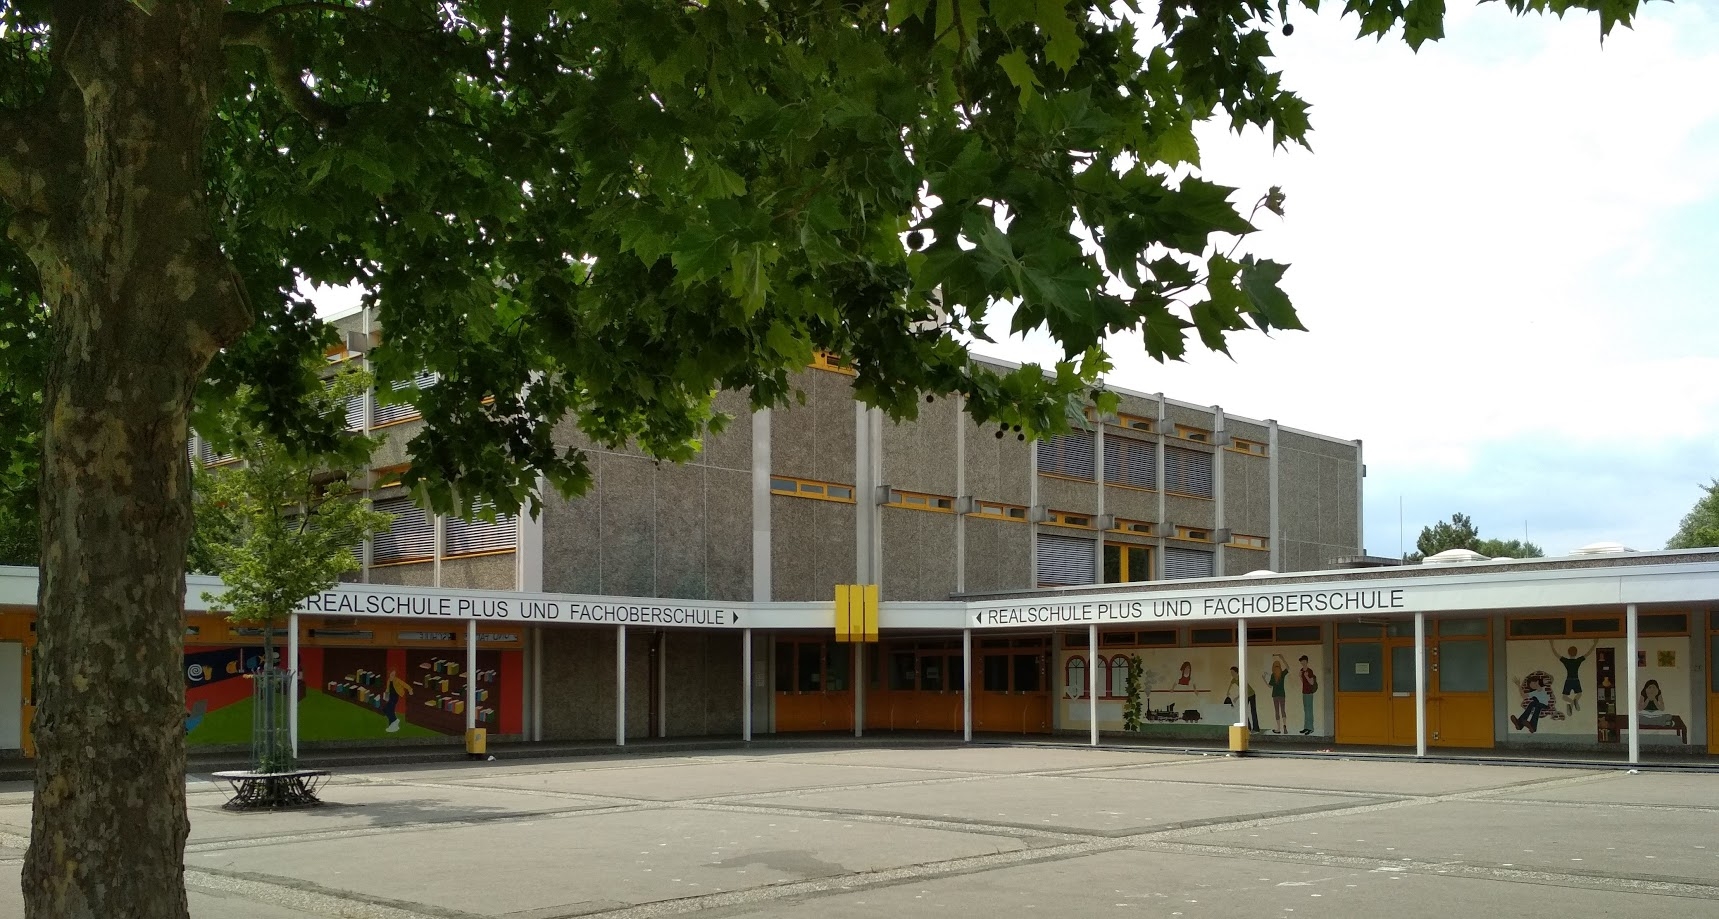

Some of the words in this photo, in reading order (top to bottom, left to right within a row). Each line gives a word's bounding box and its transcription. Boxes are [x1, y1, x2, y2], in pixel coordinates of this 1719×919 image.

[306, 593, 452, 616] REALSCHULE
[458, 599, 509, 618] PLUS
[520, 601, 560, 620] UND
[570, 603, 725, 625] FACHOBERSCHULE
[988, 604, 1092, 625] REALSCHULE
[1098, 602, 1142, 620] PLUS
[1153, 599, 1192, 618] UND
[1204, 589, 1404, 616] FACHOBERSCHULE
